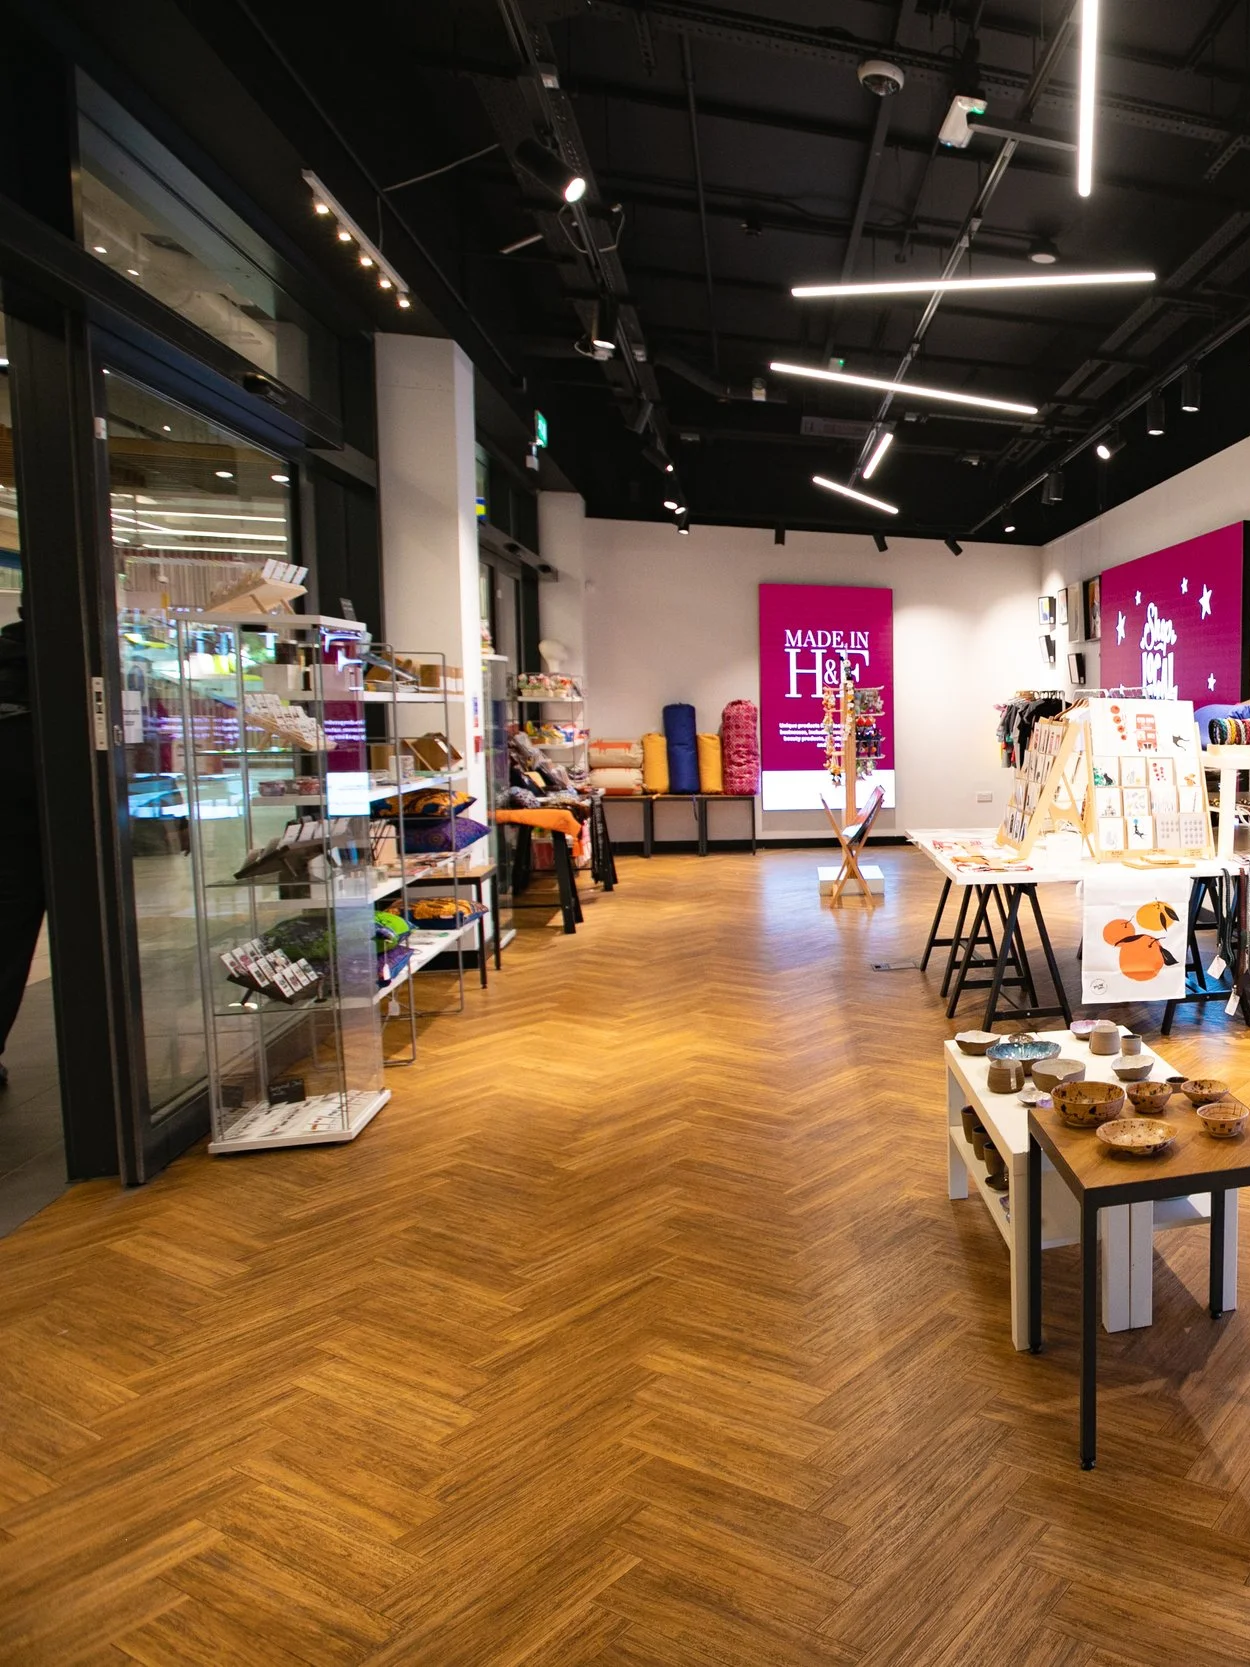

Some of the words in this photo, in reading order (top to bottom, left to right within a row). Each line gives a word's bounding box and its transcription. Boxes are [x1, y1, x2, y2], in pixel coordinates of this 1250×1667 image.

[784, 629, 844, 648] MADE
[850, 631, 869, 649] IN
[784, 648, 870, 698] H&F
